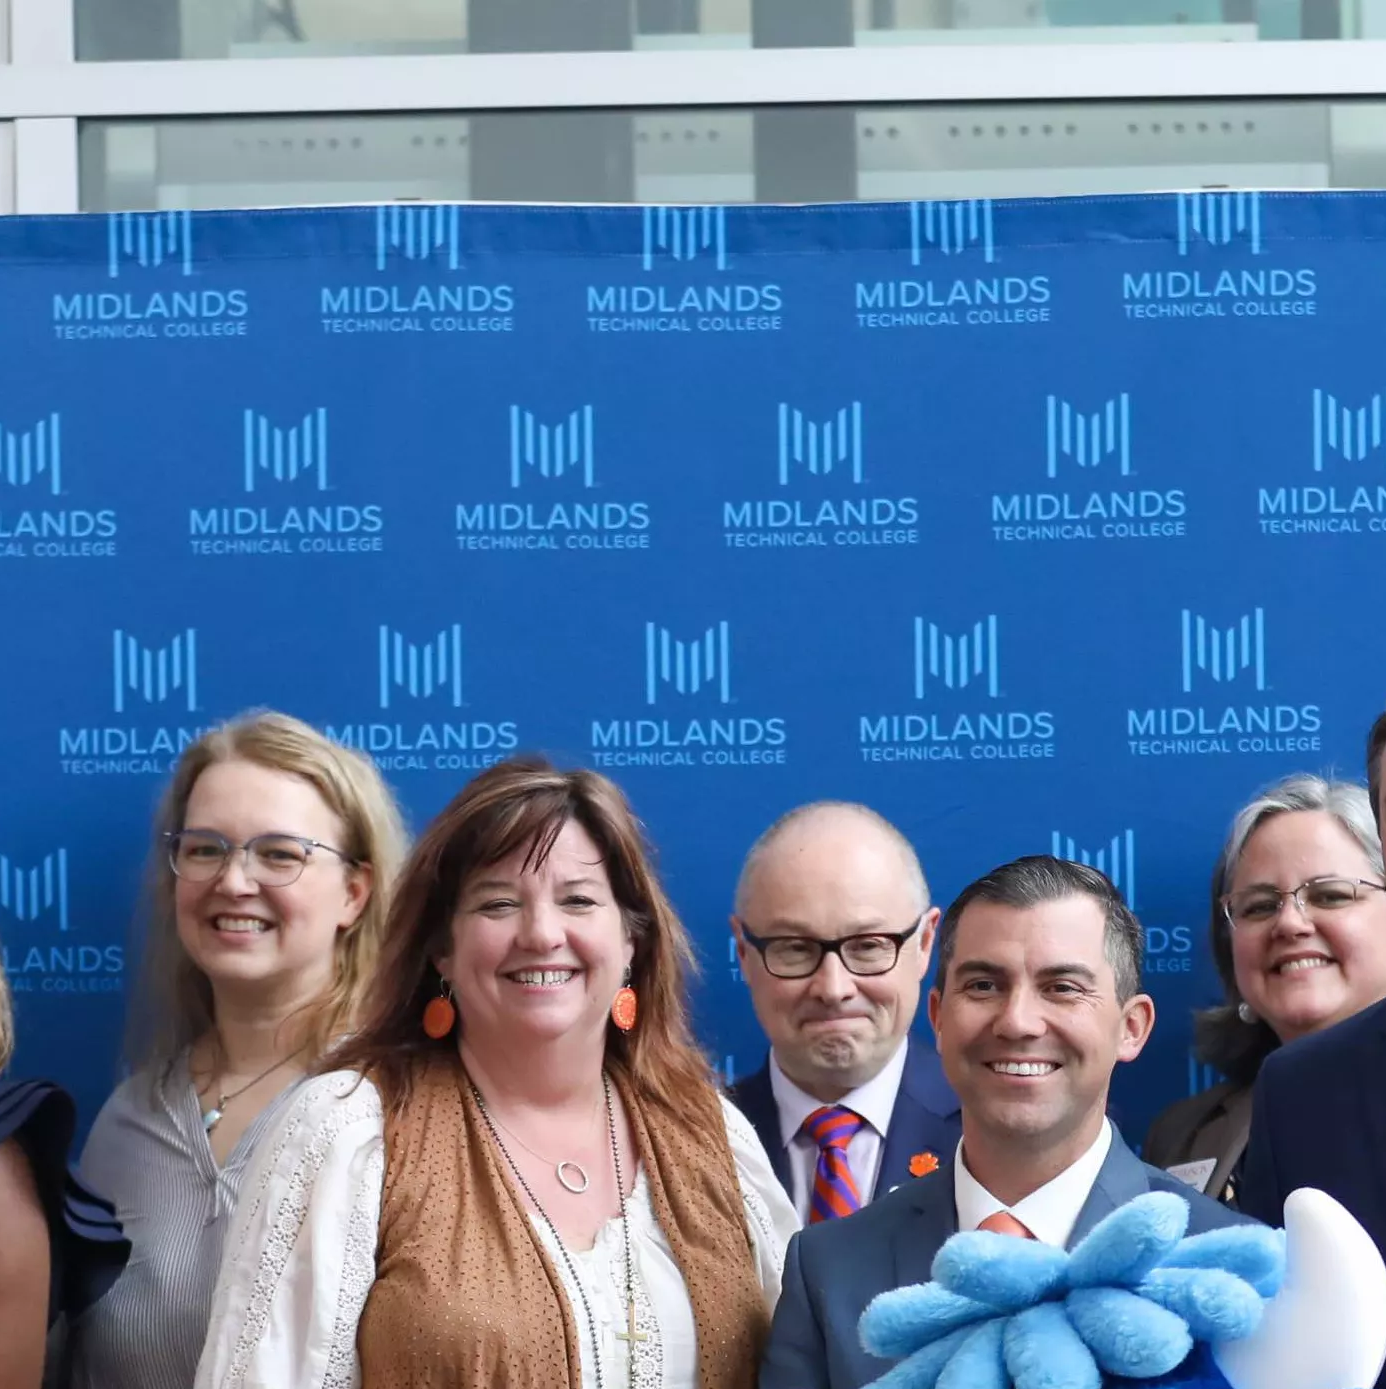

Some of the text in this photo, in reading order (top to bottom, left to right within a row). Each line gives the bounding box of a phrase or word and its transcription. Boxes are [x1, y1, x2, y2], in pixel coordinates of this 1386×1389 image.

[855, 275, 1051, 309] MIDLANDS
[1123, 268, 1317, 300] MIDLANDS
[53, 289, 249, 321] MIDLANDS
[321, 284, 514, 314] MIDLANDS
[587, 284, 782, 313] MIDLANDS
[856, 307, 1051, 328] TECHNICAL COLLEGE
[1123, 300, 1317, 319] TECHNICAL COLLEGE
[53, 320, 247, 340] TECHNICAL COLLEGE
[320, 316, 513, 334] TECHNICAL COLLEGE
[587, 315, 782, 332] TECHNICAL COLLEGE
[723, 497, 919, 528] MIDLANDS
[992, 489, 1187, 522] MIDLANDS
[189, 504, 383, 535] MIDLANDS
[455, 502, 650, 531] MIDLANDS
[1258, 517, 1362, 534] TECHNICAL
[724, 529, 919, 548] TECHNICAL COLLEGE
[992, 521, 1186, 541] TECHNICAL COLLEGE
[32, 540, 116, 558] COLLEGE
[189, 536, 383, 555] TECHNICAL COLLEGE
[456, 533, 650, 550] TECHNICAL COLLEGE
[859, 711, 1055, 743] MIDLANDS
[1127, 704, 1321, 737] MIDLANDS
[324, 721, 519, 755] MIDLANDS
[591, 717, 787, 748] MIDLANDS
[860, 742, 1055, 762] TECHNICAL COLLEGE
[1127, 735, 1321, 755] TECHNICAL COLLEGE
[60, 758, 163, 775] TECHNICAL
[592, 749, 786, 767] TECHNICAL COLLEGE
